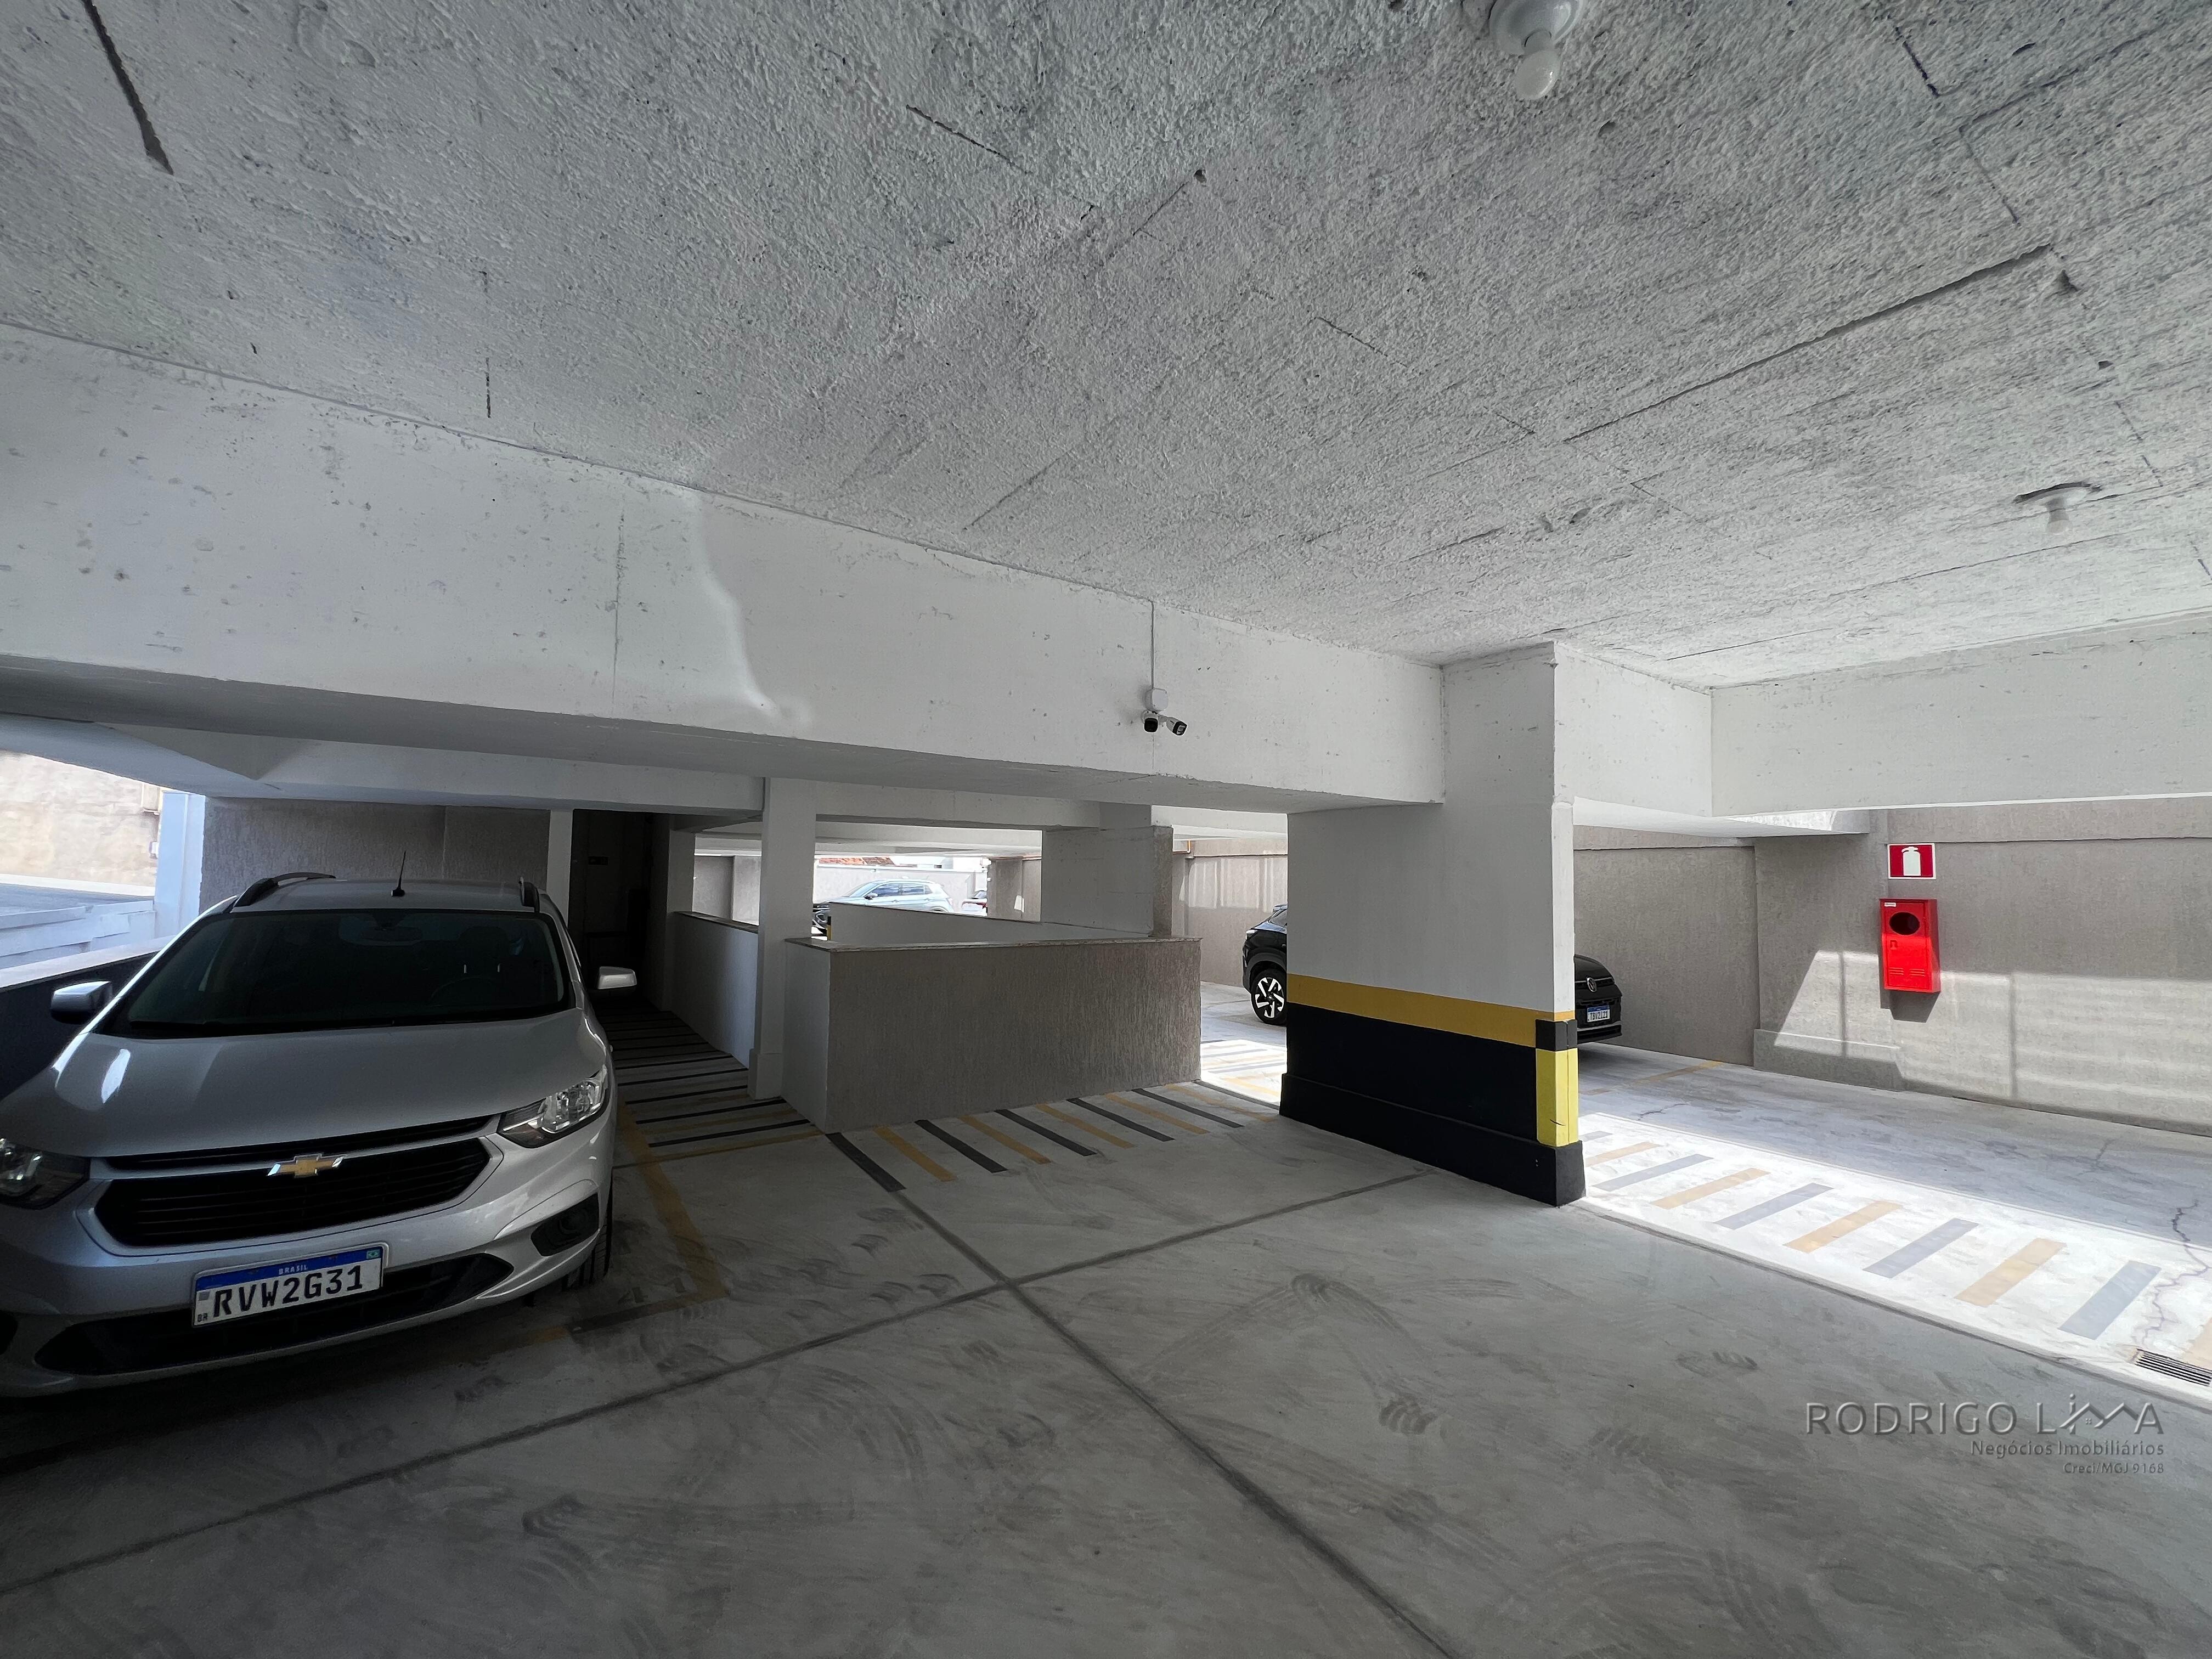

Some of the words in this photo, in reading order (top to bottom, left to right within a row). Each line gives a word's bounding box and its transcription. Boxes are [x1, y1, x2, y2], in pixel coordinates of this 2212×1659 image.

[279, 1264, 308, 1275] BRASIL
[212, 1264, 363, 1317] RVW2G31
[198, 1312, 208, 1322] BR
